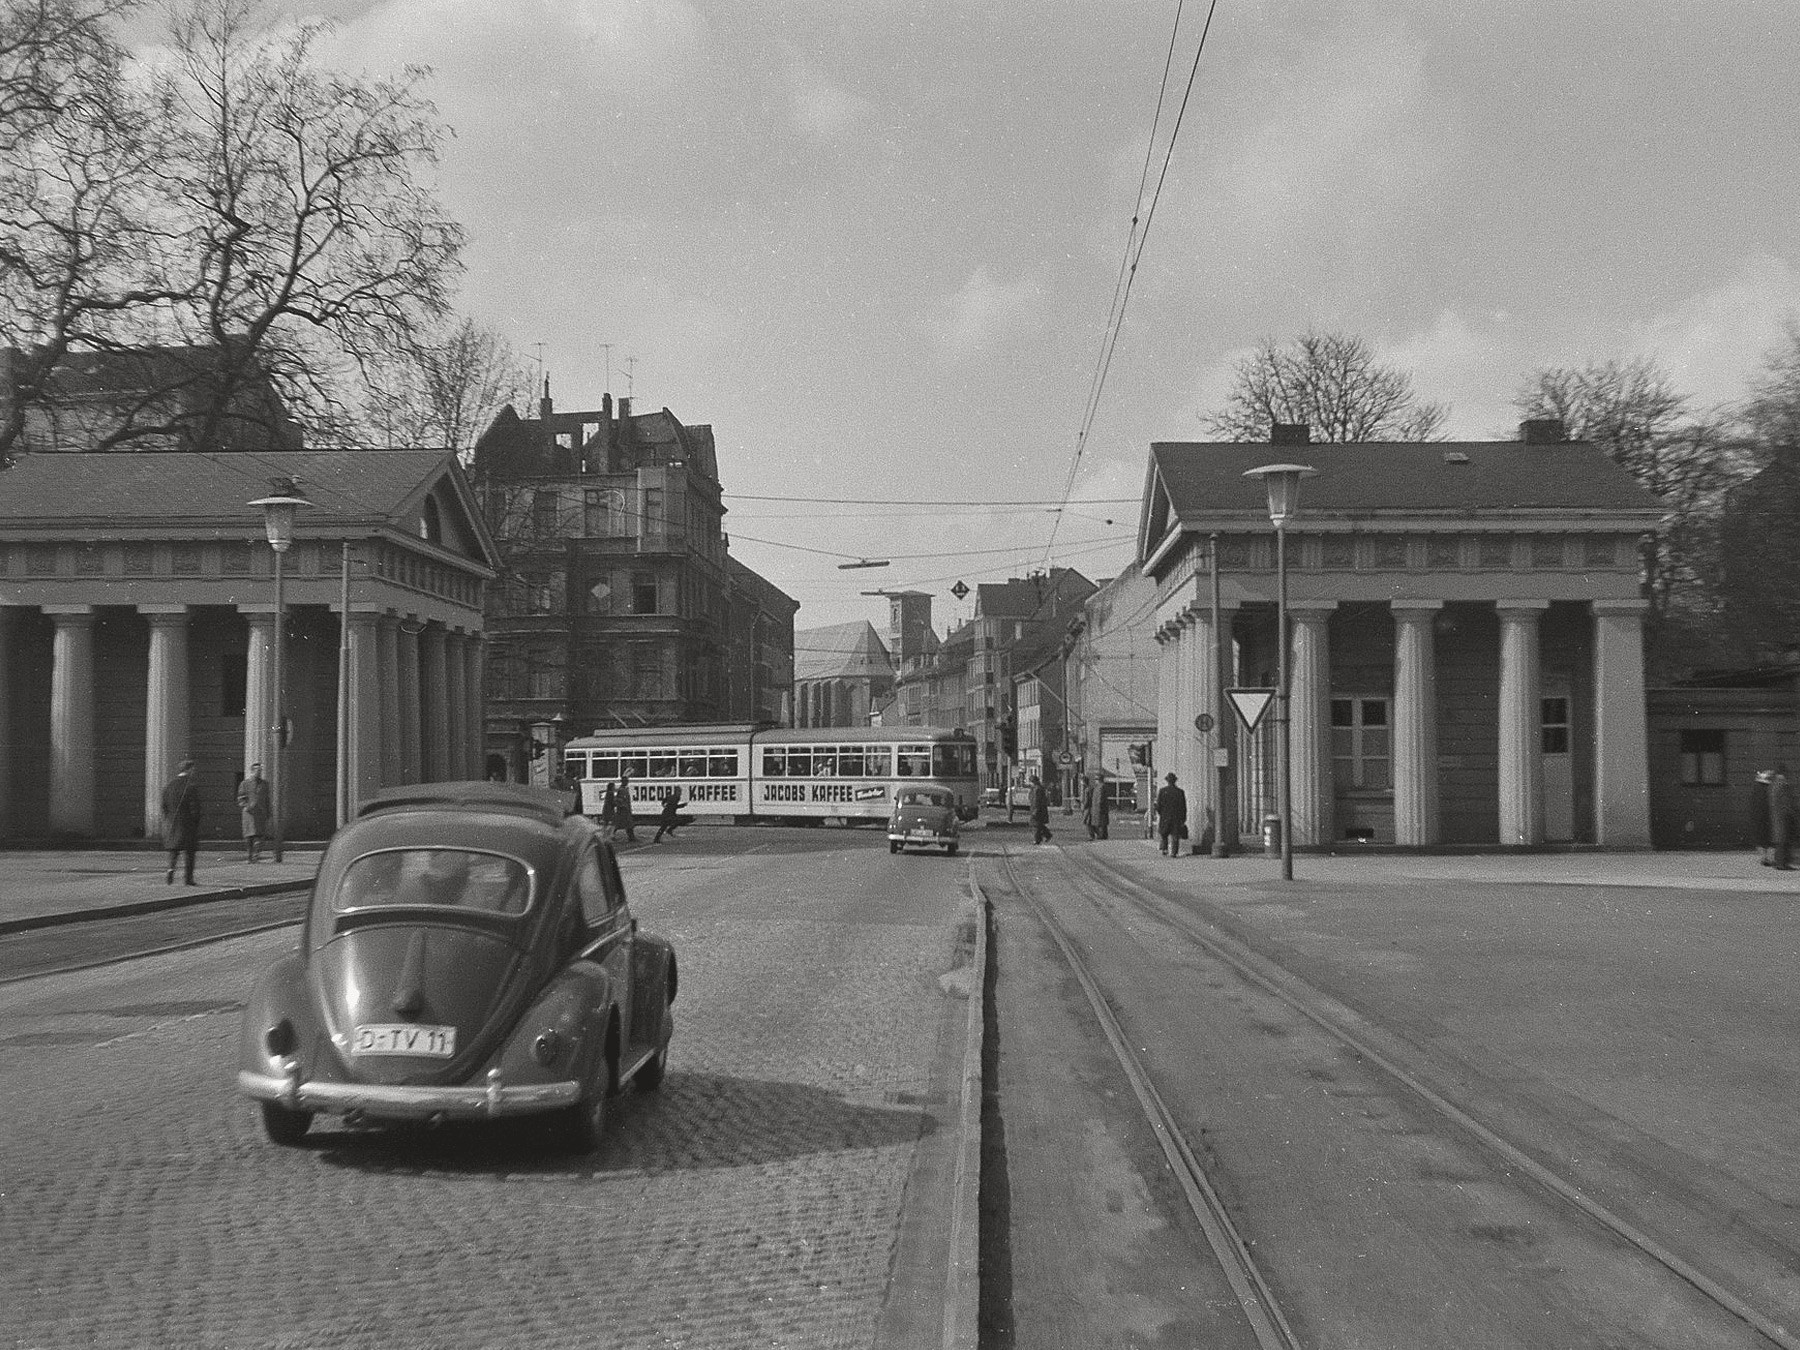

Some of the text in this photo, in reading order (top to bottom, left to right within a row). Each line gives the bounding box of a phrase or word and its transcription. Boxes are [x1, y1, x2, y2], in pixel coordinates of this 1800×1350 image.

[632, 785, 736, 801] JACOB KAFFEE
[764, 785, 805, 801] JACOBS
[812, 785, 853, 802] KAFFEE
